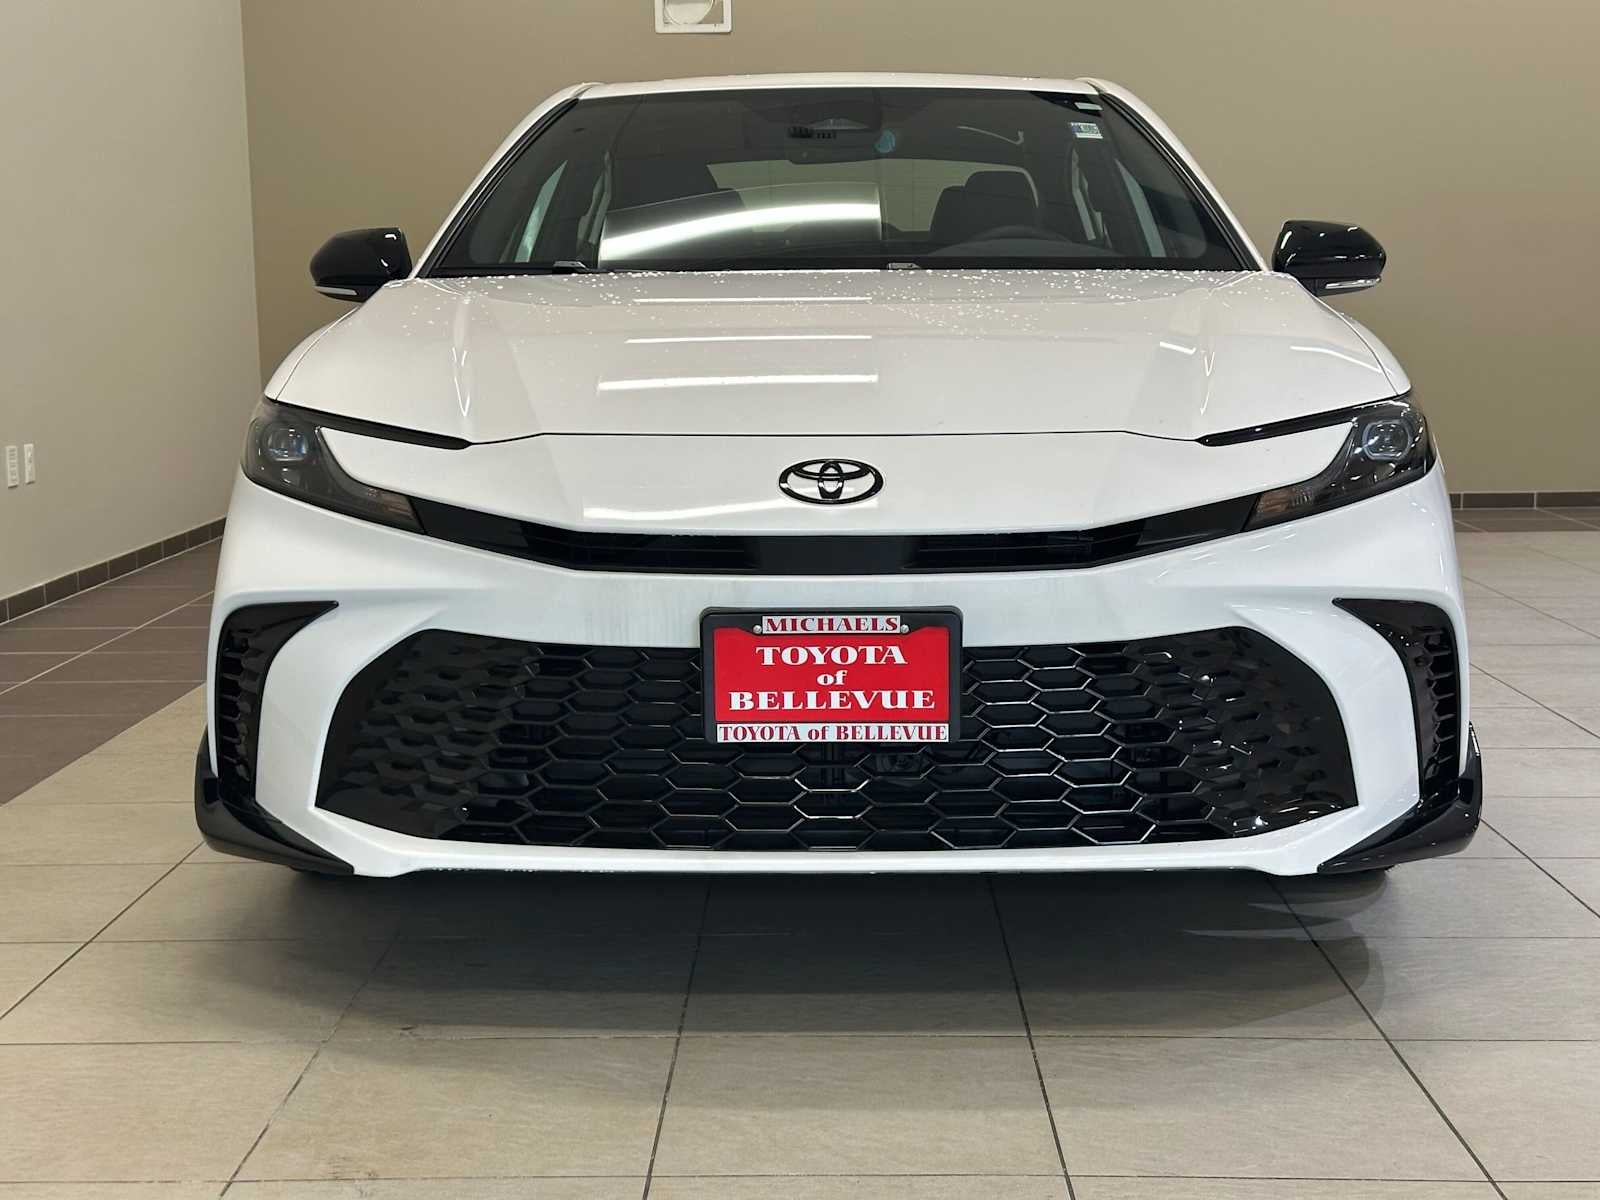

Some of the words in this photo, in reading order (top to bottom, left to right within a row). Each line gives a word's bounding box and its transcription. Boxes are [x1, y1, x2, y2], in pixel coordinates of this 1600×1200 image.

[766, 617, 898, 632] MICHAELS
[755, 645, 908, 665] TOYOTA
[816, 670, 848, 686] of
[728, 690, 935, 710] BELLEVUE
[719, 725, 800, 741] TOYOTA
[807, 725, 829, 741] of
[834, 725, 948, 741] BELLEVUE
